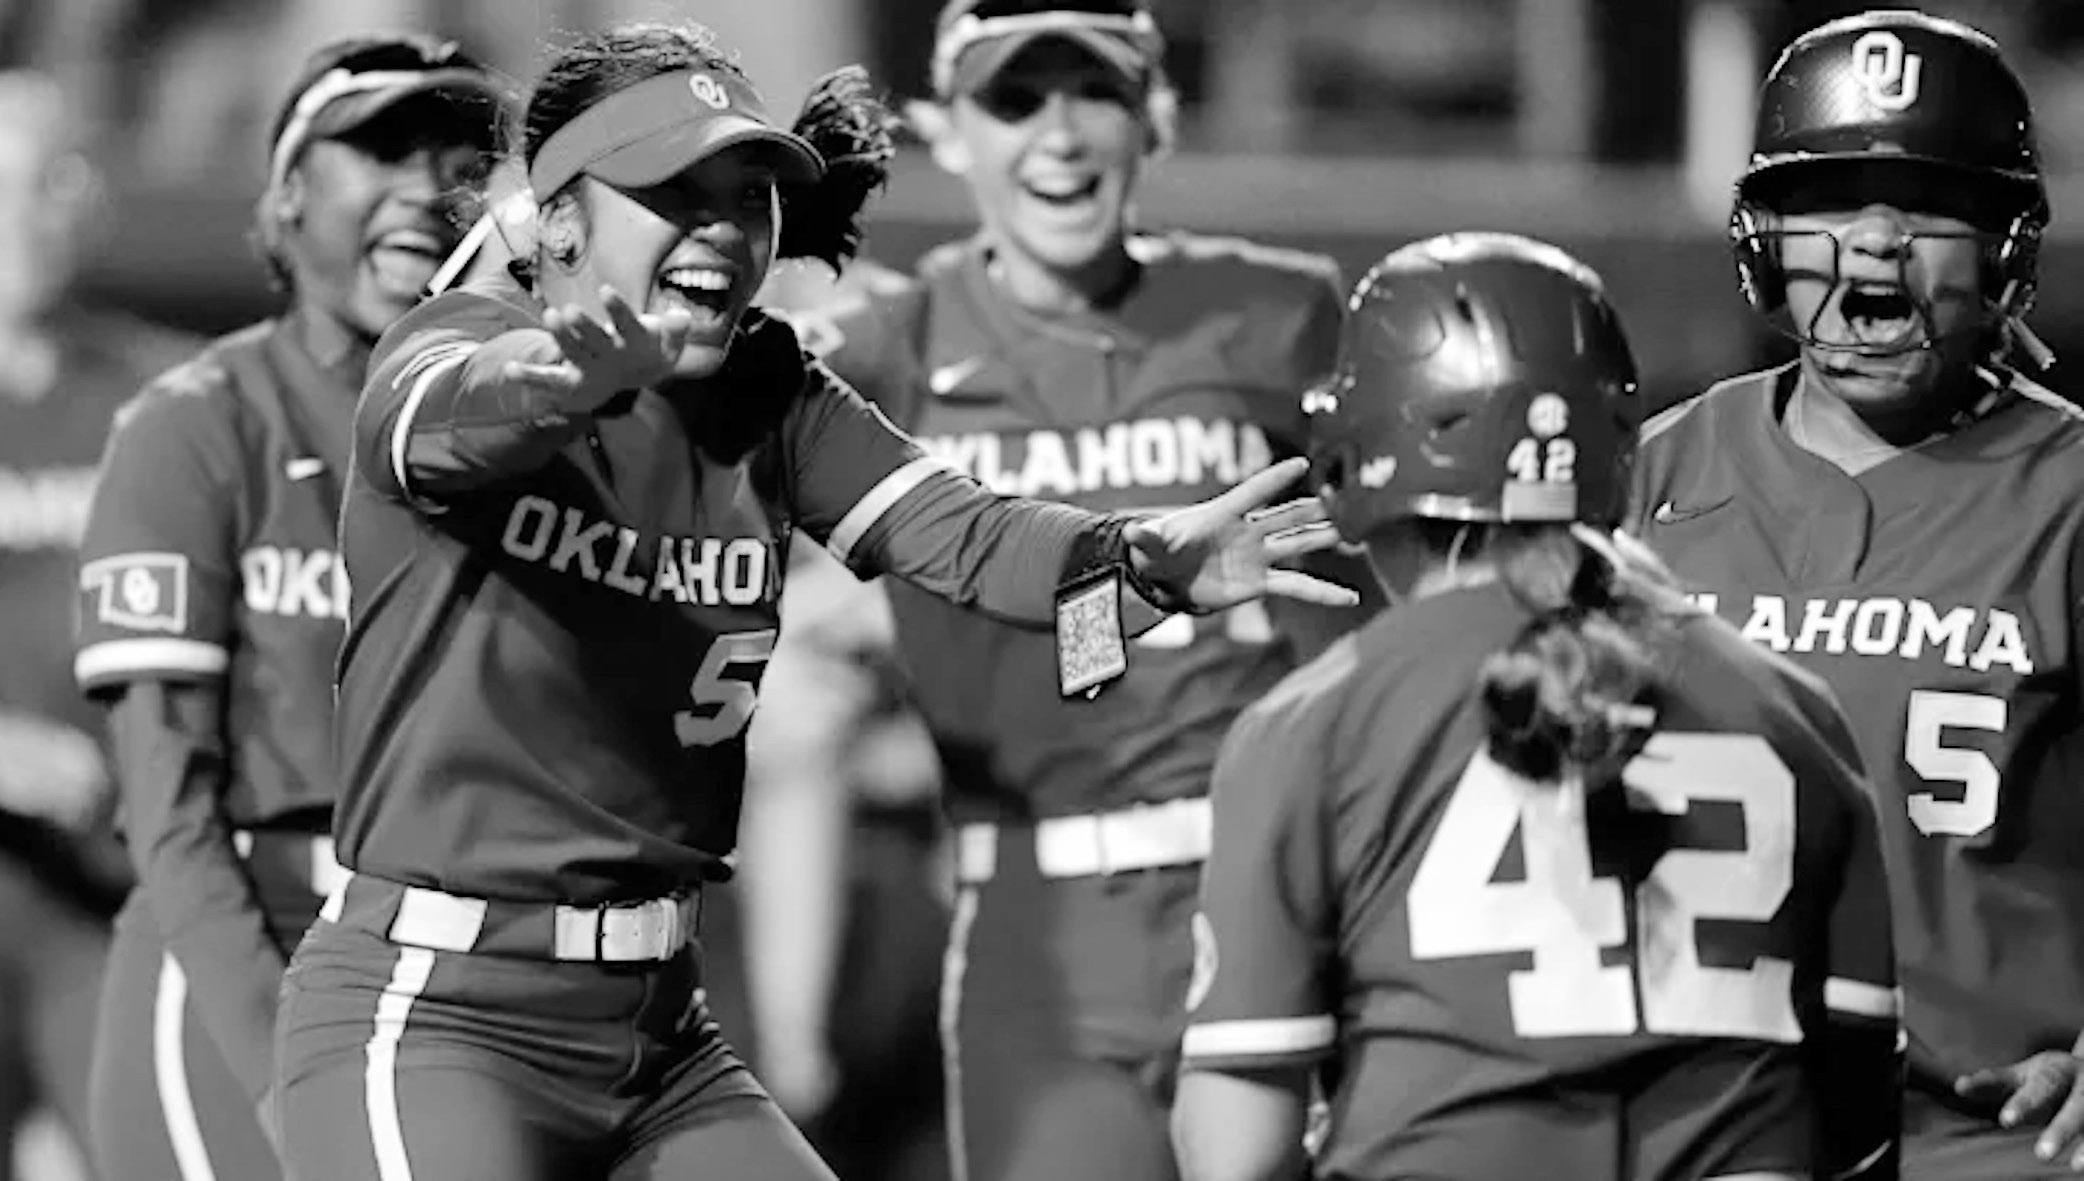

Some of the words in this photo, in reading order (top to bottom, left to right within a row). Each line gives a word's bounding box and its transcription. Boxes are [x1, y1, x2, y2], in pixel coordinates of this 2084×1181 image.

[1852, 30, 1922, 110] OU
[1506, 437, 1576, 482] 42
[673, 628, 777, 747] 5
[1905, 690, 2008, 838] 5
[1407, 733, 1803, 1044] 42
